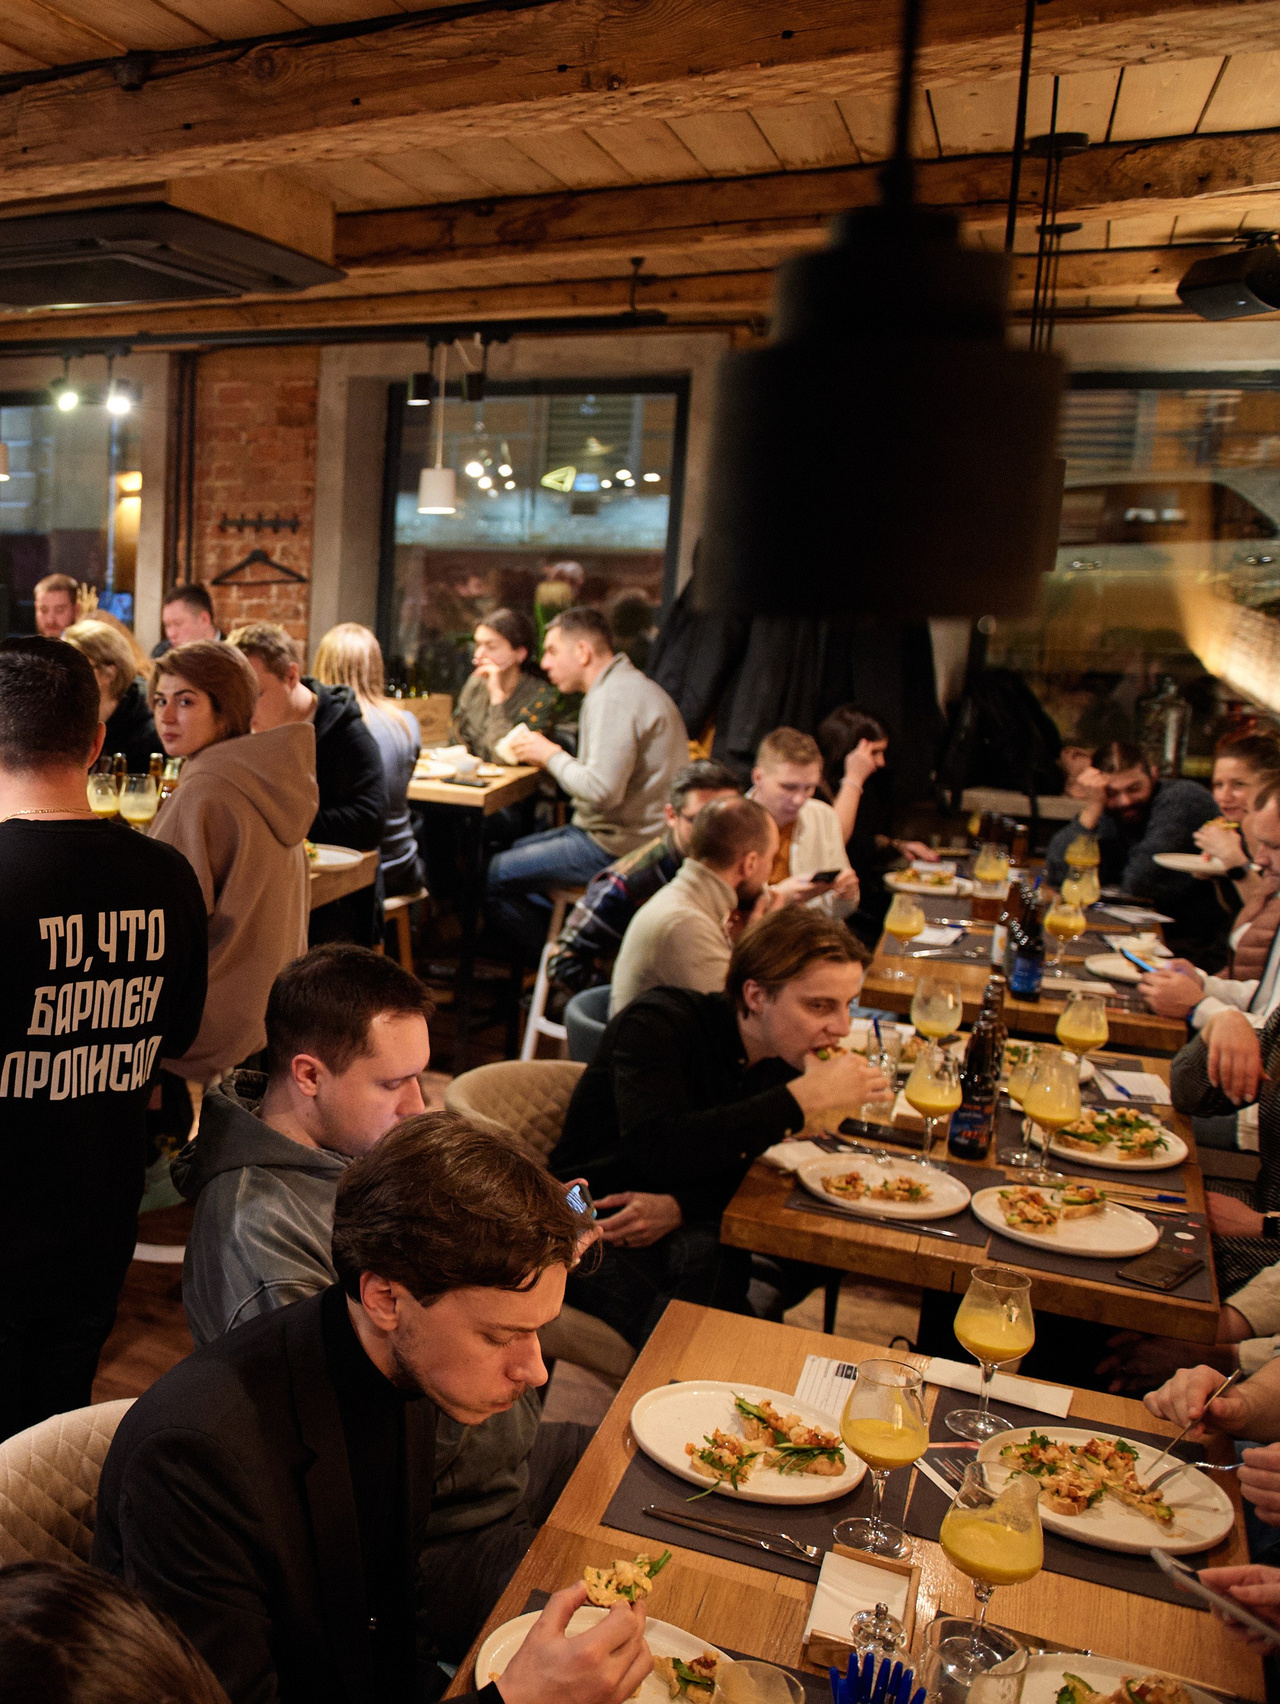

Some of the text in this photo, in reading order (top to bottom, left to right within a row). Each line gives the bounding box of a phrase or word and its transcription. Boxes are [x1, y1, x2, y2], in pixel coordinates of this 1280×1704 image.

[39, 908, 166, 972] ТО, ЧТО
[26, 975, 165, 1036] БАРМЕН
[0, 1035, 163, 1101] ПРОПИСАЛ
